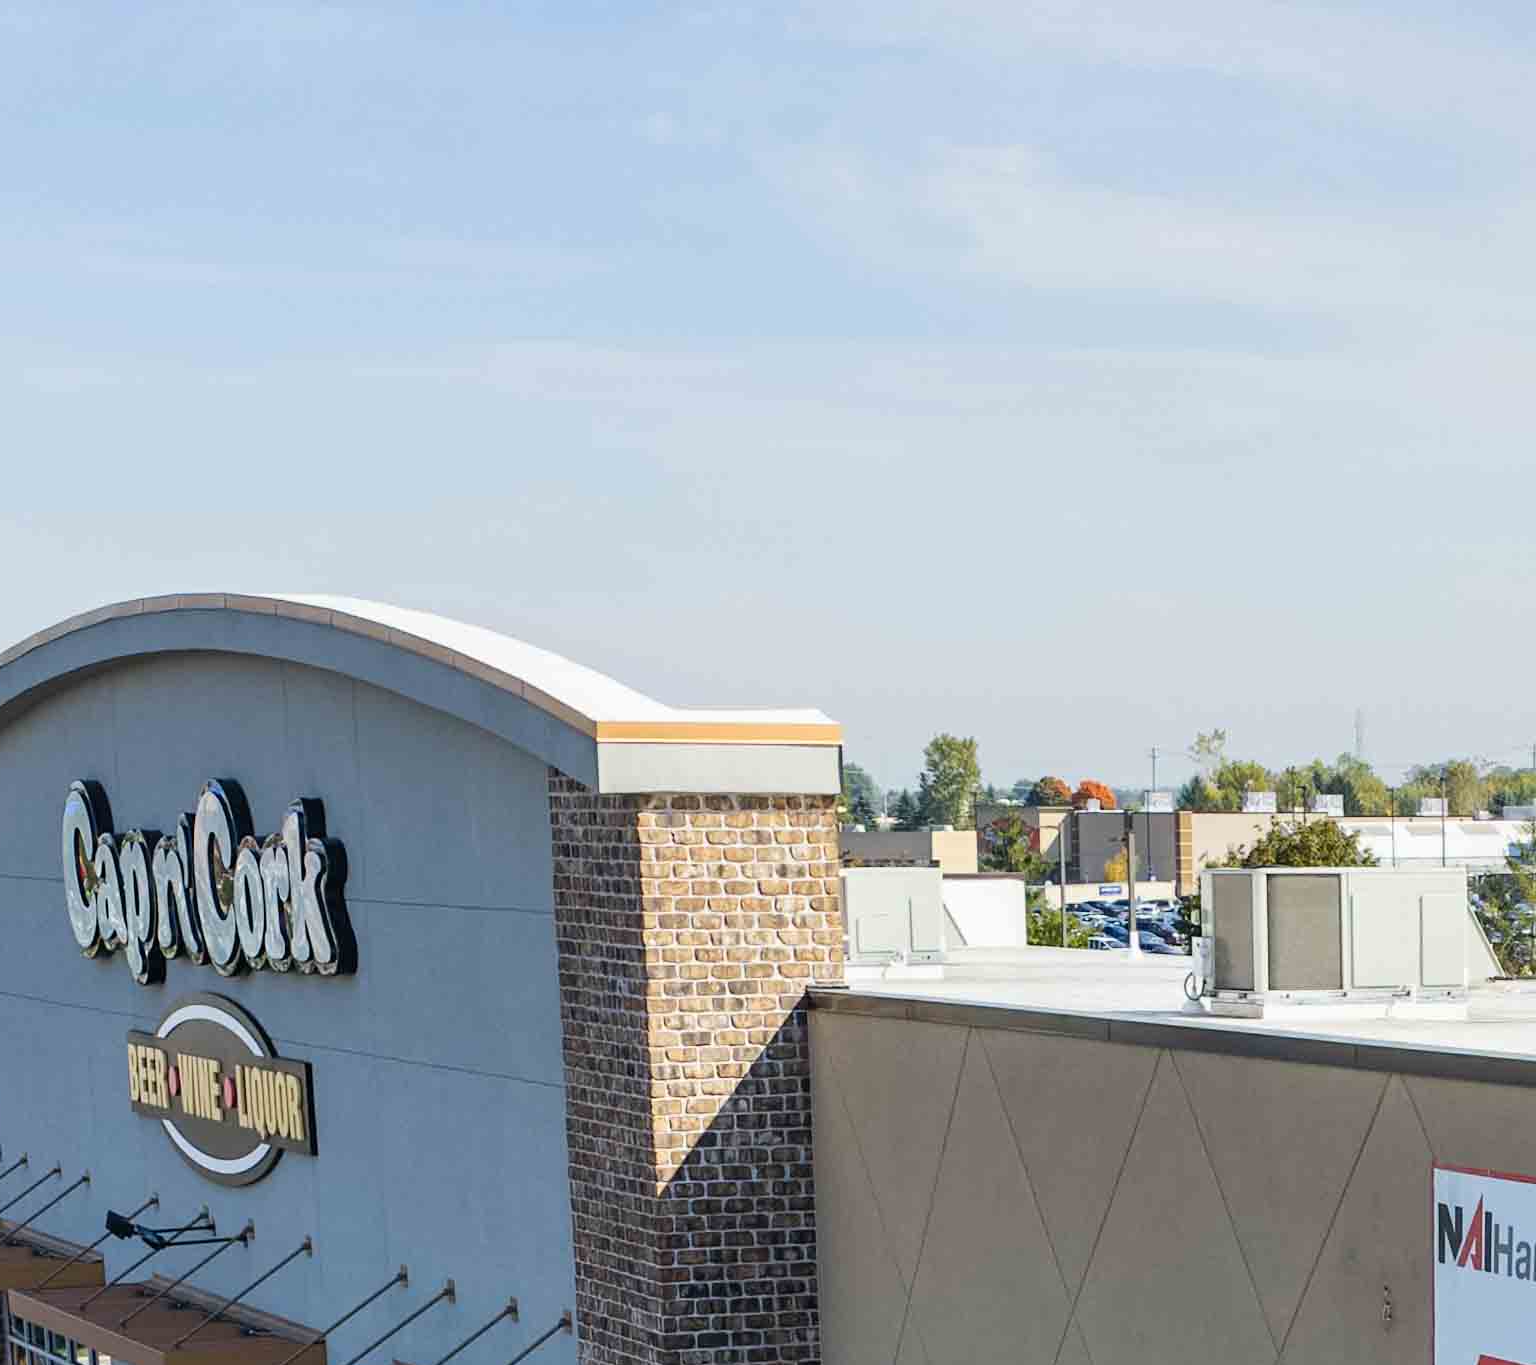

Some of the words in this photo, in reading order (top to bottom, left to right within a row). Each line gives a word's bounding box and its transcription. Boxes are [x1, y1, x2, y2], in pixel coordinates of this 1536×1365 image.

[127, 1042, 169, 1109] BEER
[177, 1052, 224, 1121] WINE
[235, 1063, 305, 1141] LIQUOR
[1438, 1194, 1492, 1272] NAI
